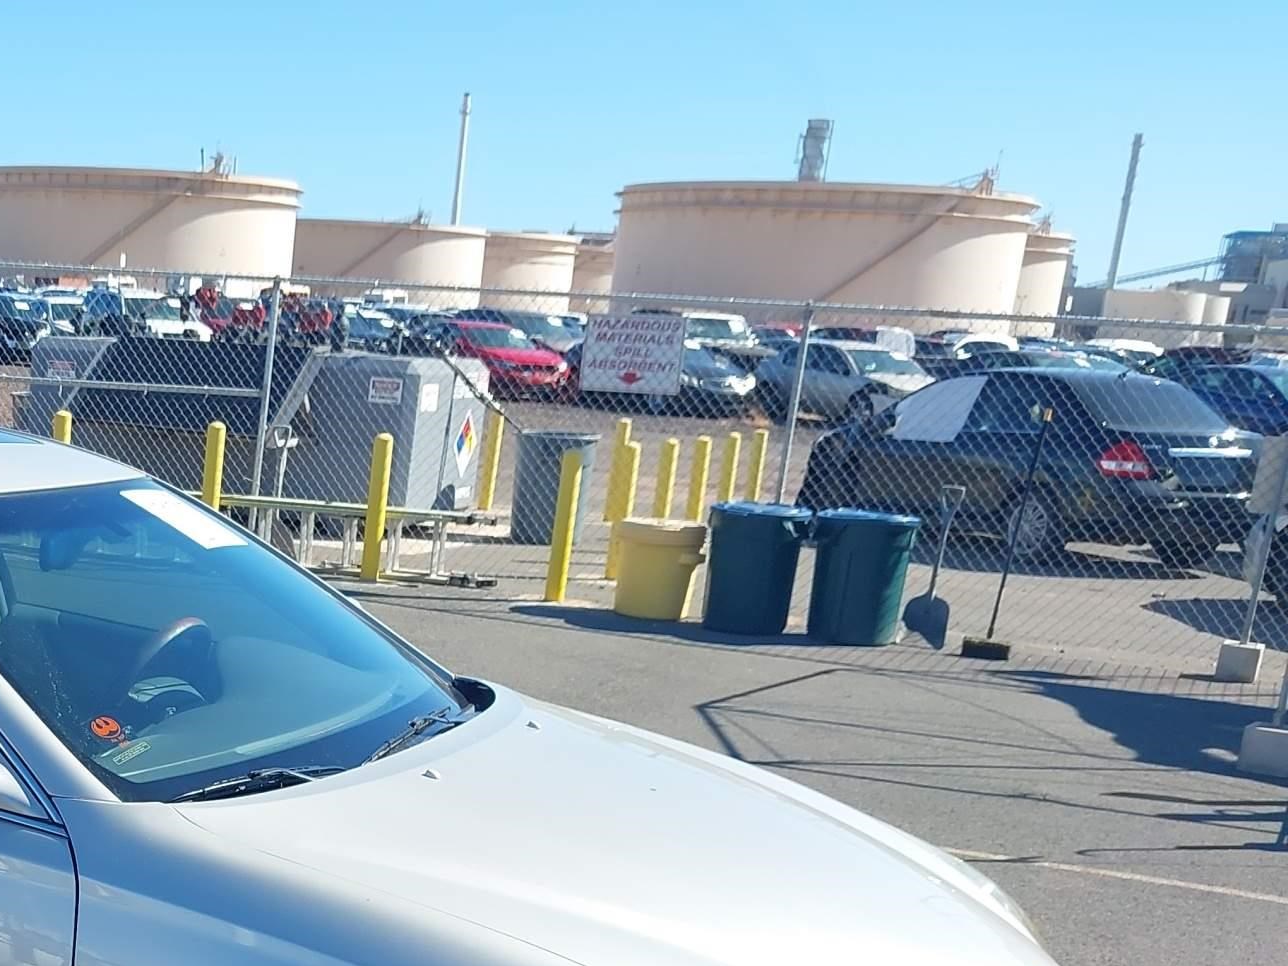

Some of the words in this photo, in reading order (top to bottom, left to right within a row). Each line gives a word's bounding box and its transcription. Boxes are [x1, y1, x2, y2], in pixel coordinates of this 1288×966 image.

[592, 318, 683, 333] HAZARDOUS
[594, 331, 675, 346] MATERIALS
[615, 345, 652, 359] SPILL
[587, 357, 677, 374] ABSORBENT
